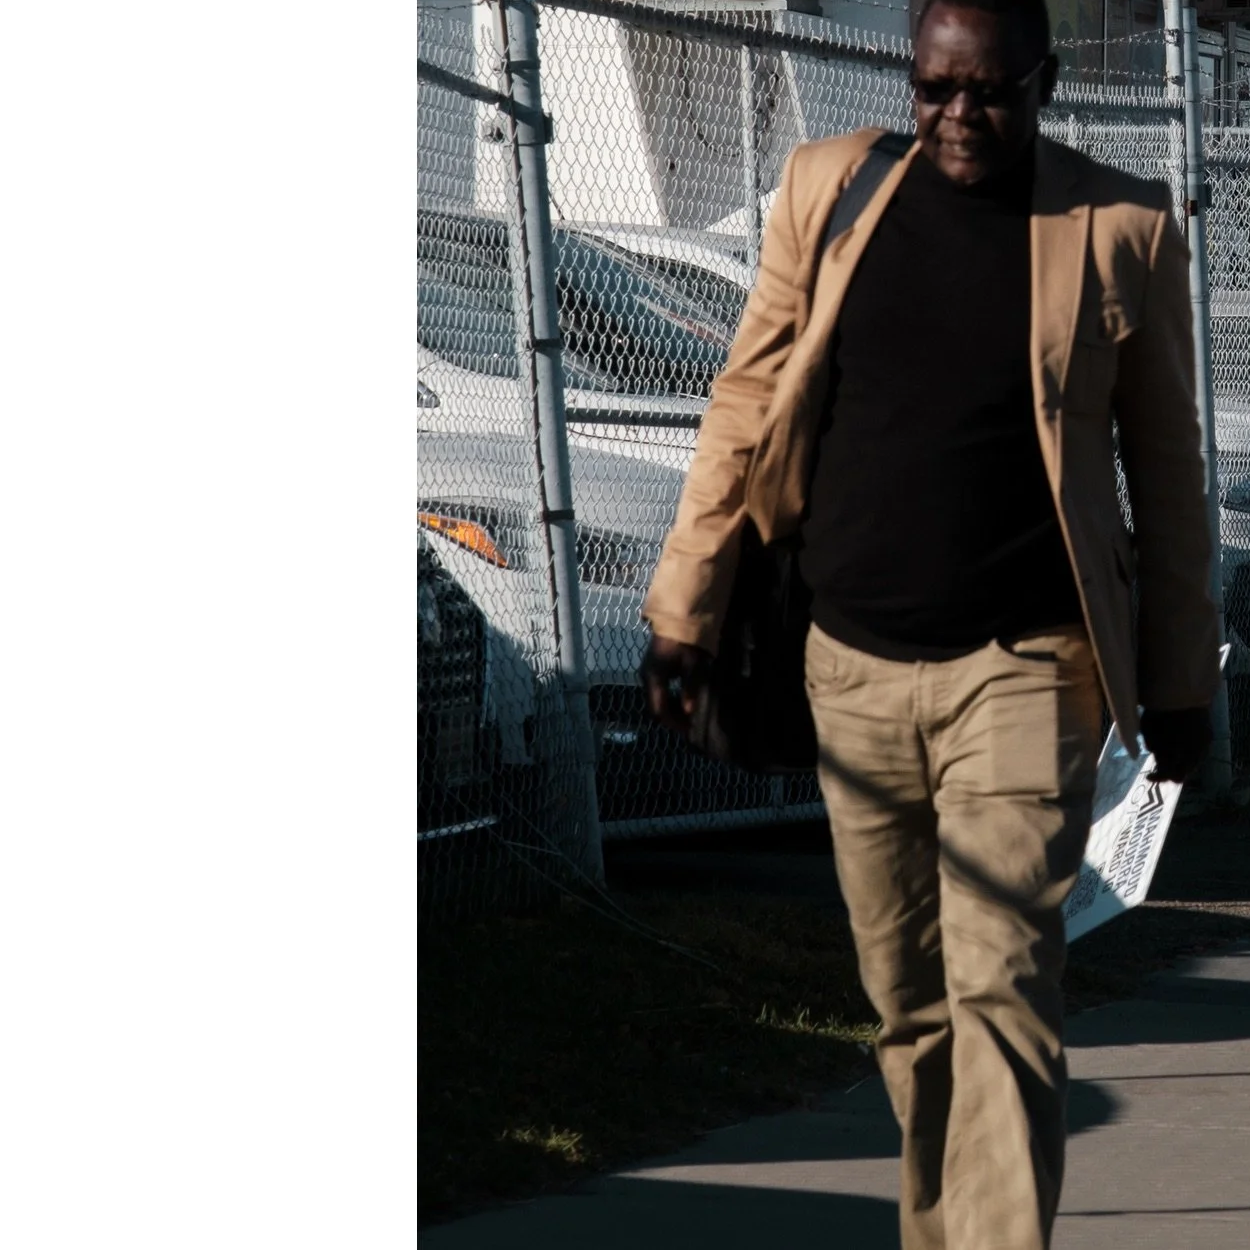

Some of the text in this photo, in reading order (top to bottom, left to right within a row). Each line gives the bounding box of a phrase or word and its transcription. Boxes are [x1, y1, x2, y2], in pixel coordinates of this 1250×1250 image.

[1109, 825, 1132, 873] WARD
[1113, 815, 1147, 893] MOURRA
[1124, 807, 1163, 898] MAHMOUD
